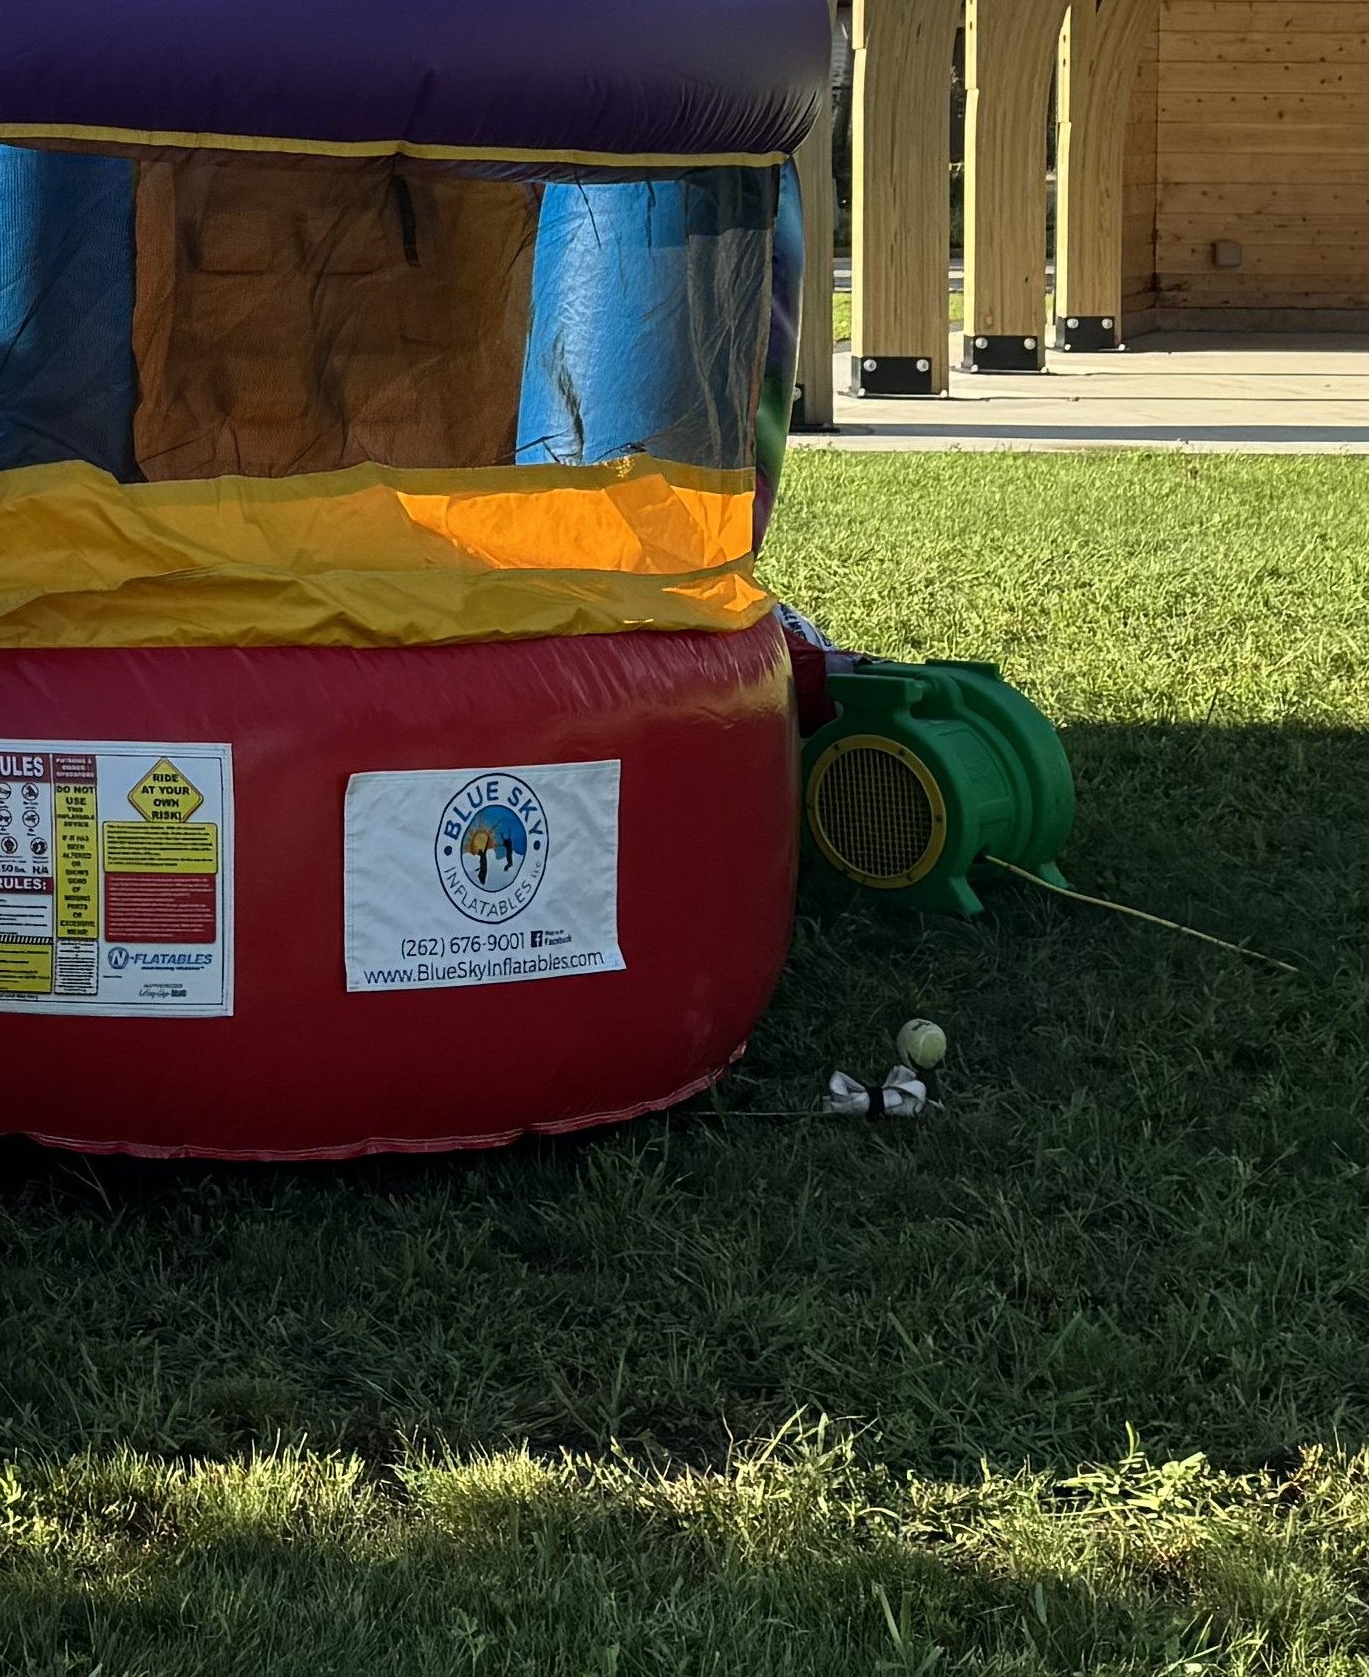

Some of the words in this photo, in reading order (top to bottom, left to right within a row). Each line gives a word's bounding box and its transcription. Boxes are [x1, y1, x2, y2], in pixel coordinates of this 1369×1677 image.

[152, 773, 179, 783] RIDE
[56, 785, 71, 794] DO
[73, 786, 94, 794] NOT
[141, 785, 155, 795] AT
[158, 786, 191, 796] YOUR
[65, 796, 87, 806] USE
[153, 798, 180, 808] OWN
[443, 780, 500, 841] BLUE
[506, 786, 545, 836] SKY
[443, 866, 533, 918] INFLATABLES
[401, 937, 446, 960] (262)
[449, 932, 525, 954] 676-9001
[363, 951, 605, 985] www.BlueSkyInflatables.com
